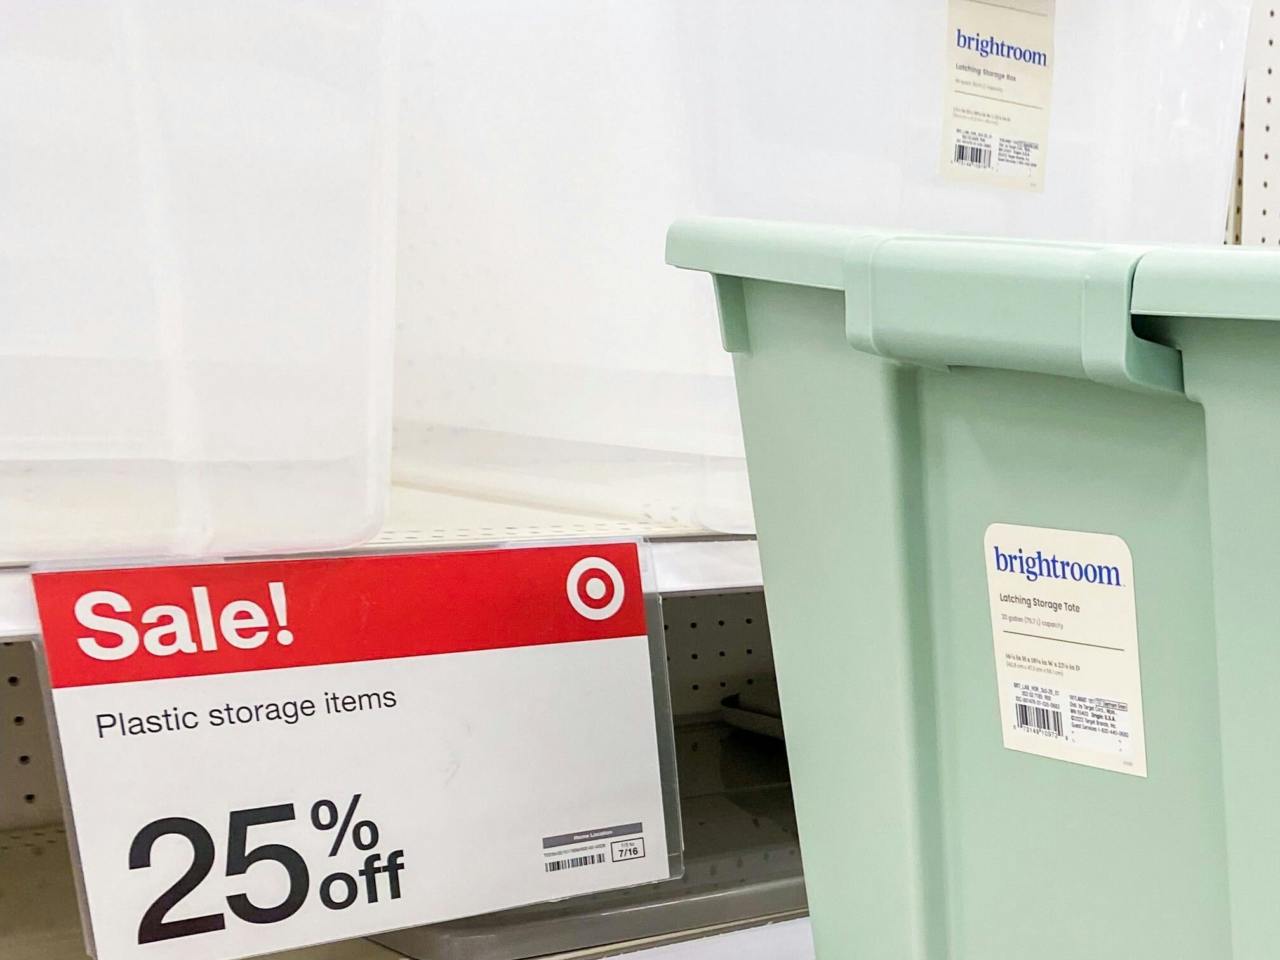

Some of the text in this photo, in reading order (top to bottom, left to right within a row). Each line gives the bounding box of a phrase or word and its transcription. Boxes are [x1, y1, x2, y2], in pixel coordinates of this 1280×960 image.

[956, 29, 1048, 66] brightroom
[993, 545, 1122, 587] brightroom
[73, 581, 294, 661] Sale!
[1000, 592, 1080, 613] Latching Storage Tote
[96, 690, 397, 738] Plastic storage items
[618, 847, 638, 858] 7/16
[319, 849, 405, 910] off
